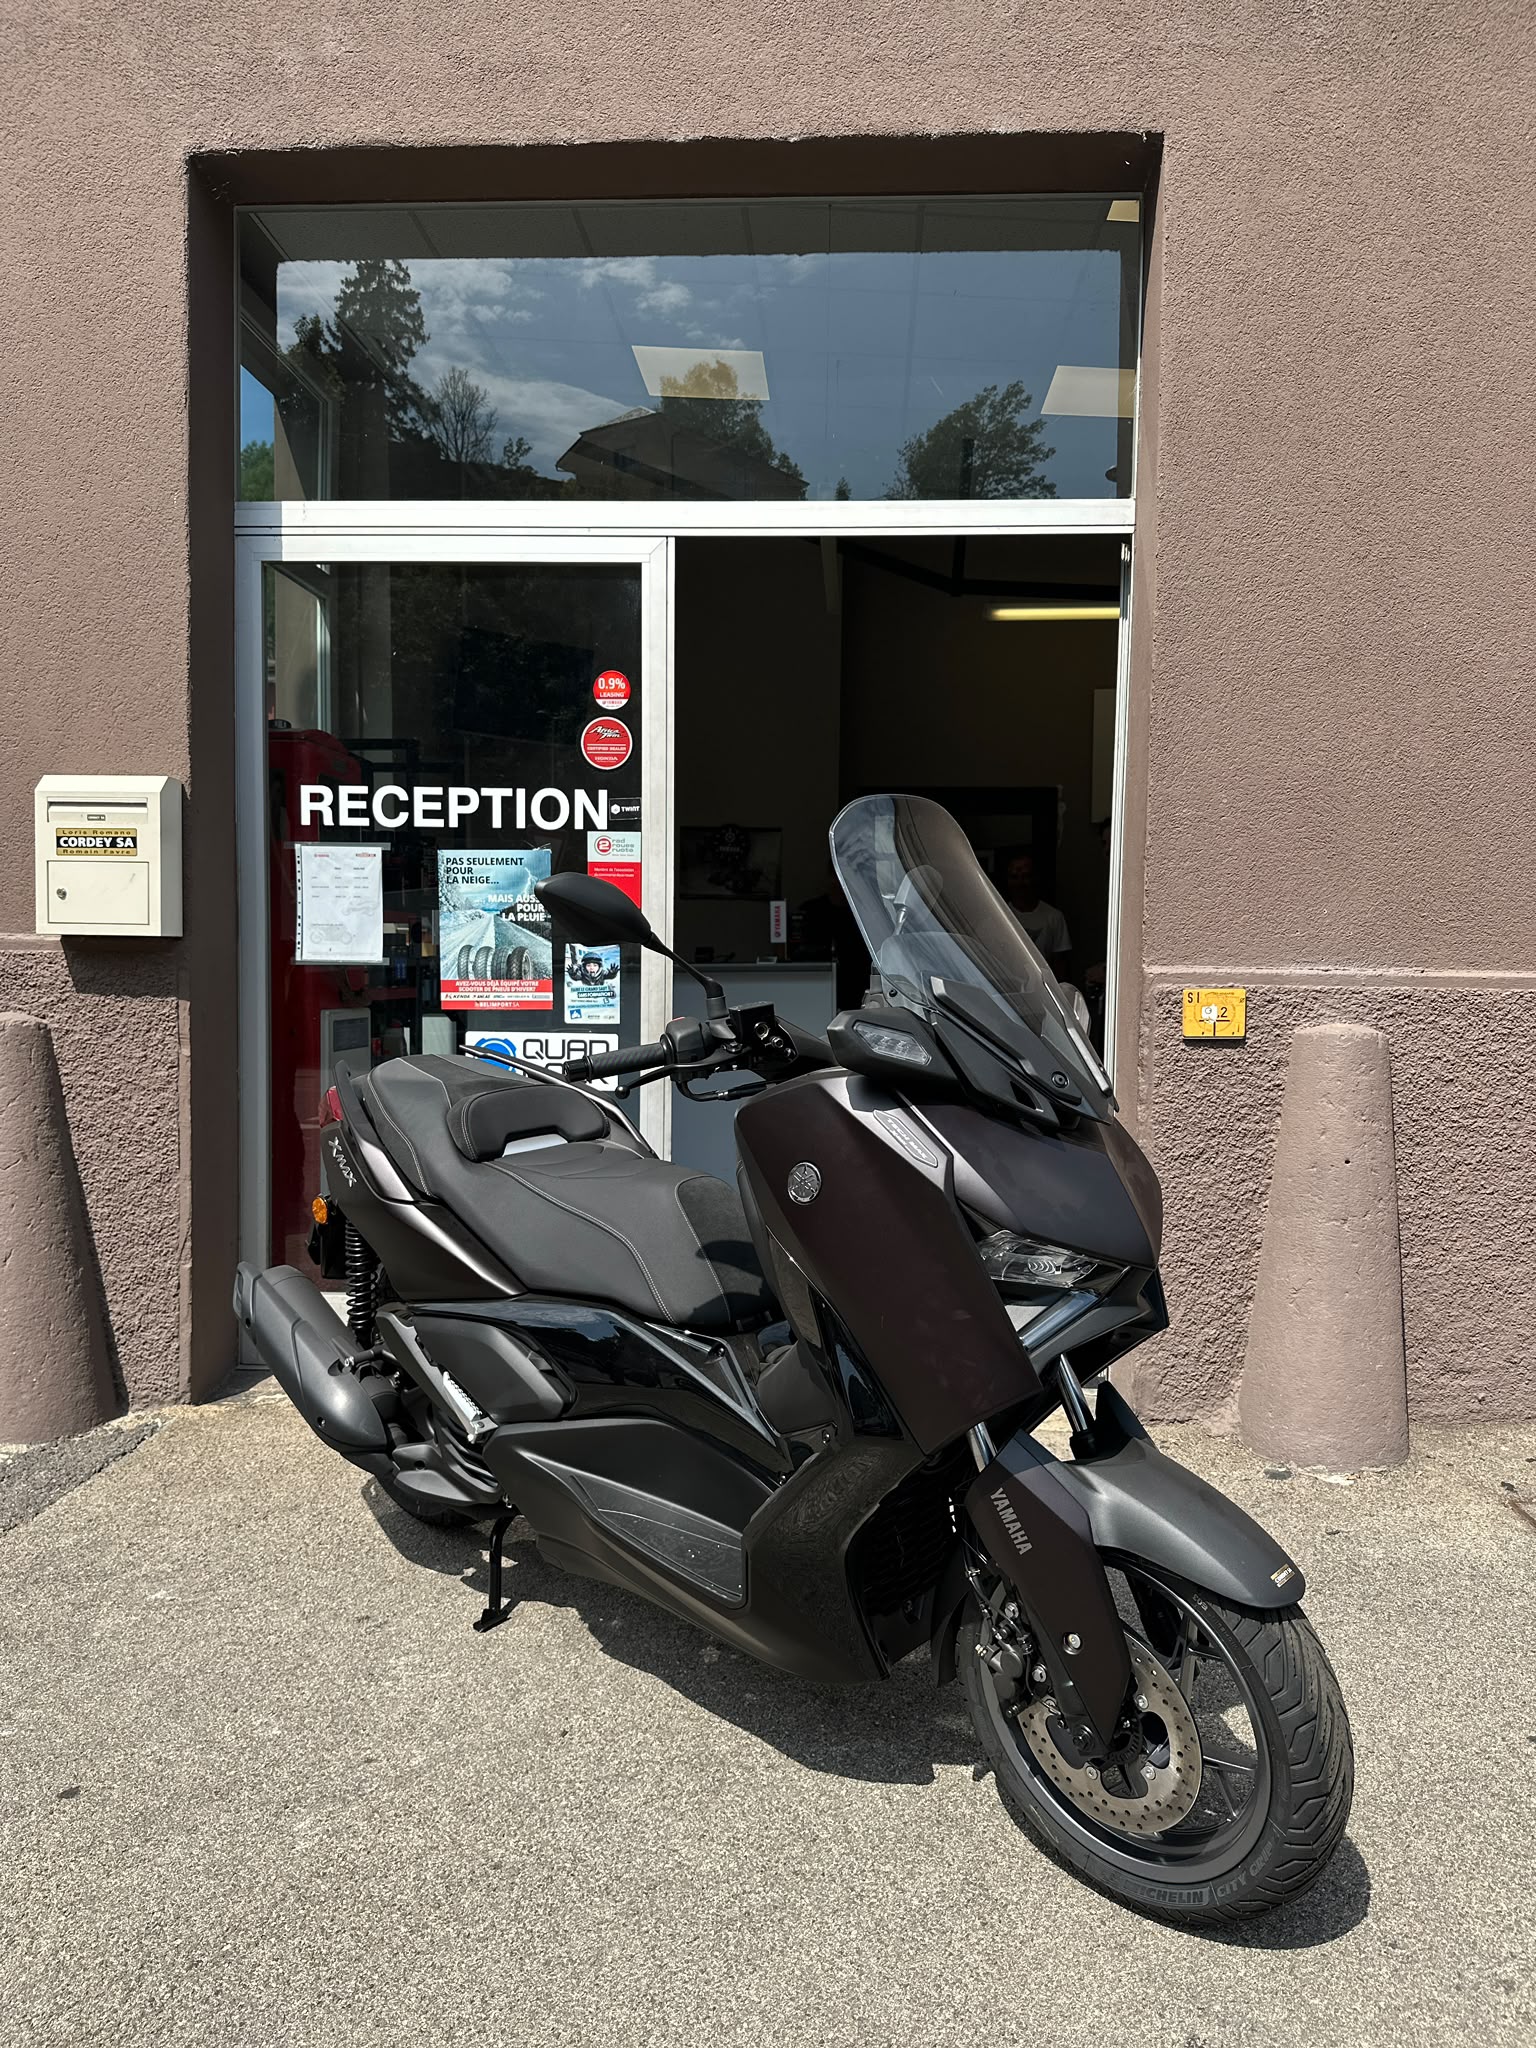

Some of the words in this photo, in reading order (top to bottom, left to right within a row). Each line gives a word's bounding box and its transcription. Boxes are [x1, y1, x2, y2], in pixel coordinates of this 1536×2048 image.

[598, 677, 626, 689] 0.9%
[300, 784, 608, 831] RECEPTION
[60, 836, 112, 848] CORDEY
[116, 837, 135, 848] SA
[446, 857, 464, 865] PAS
[466, 857, 525, 866] SEULEMENT
[446, 867, 474, 875] POUR
[446, 876, 461, 884] LA
[462, 876, 499, 885] NEIGE...
[487, 894, 514, 903] MAIS
[516, 903, 545, 912] POUR
[502, 913, 516, 921] LA
[523, 1038, 610, 1060] QUAD
[990, 1487, 1033, 1555] YAMAHA
